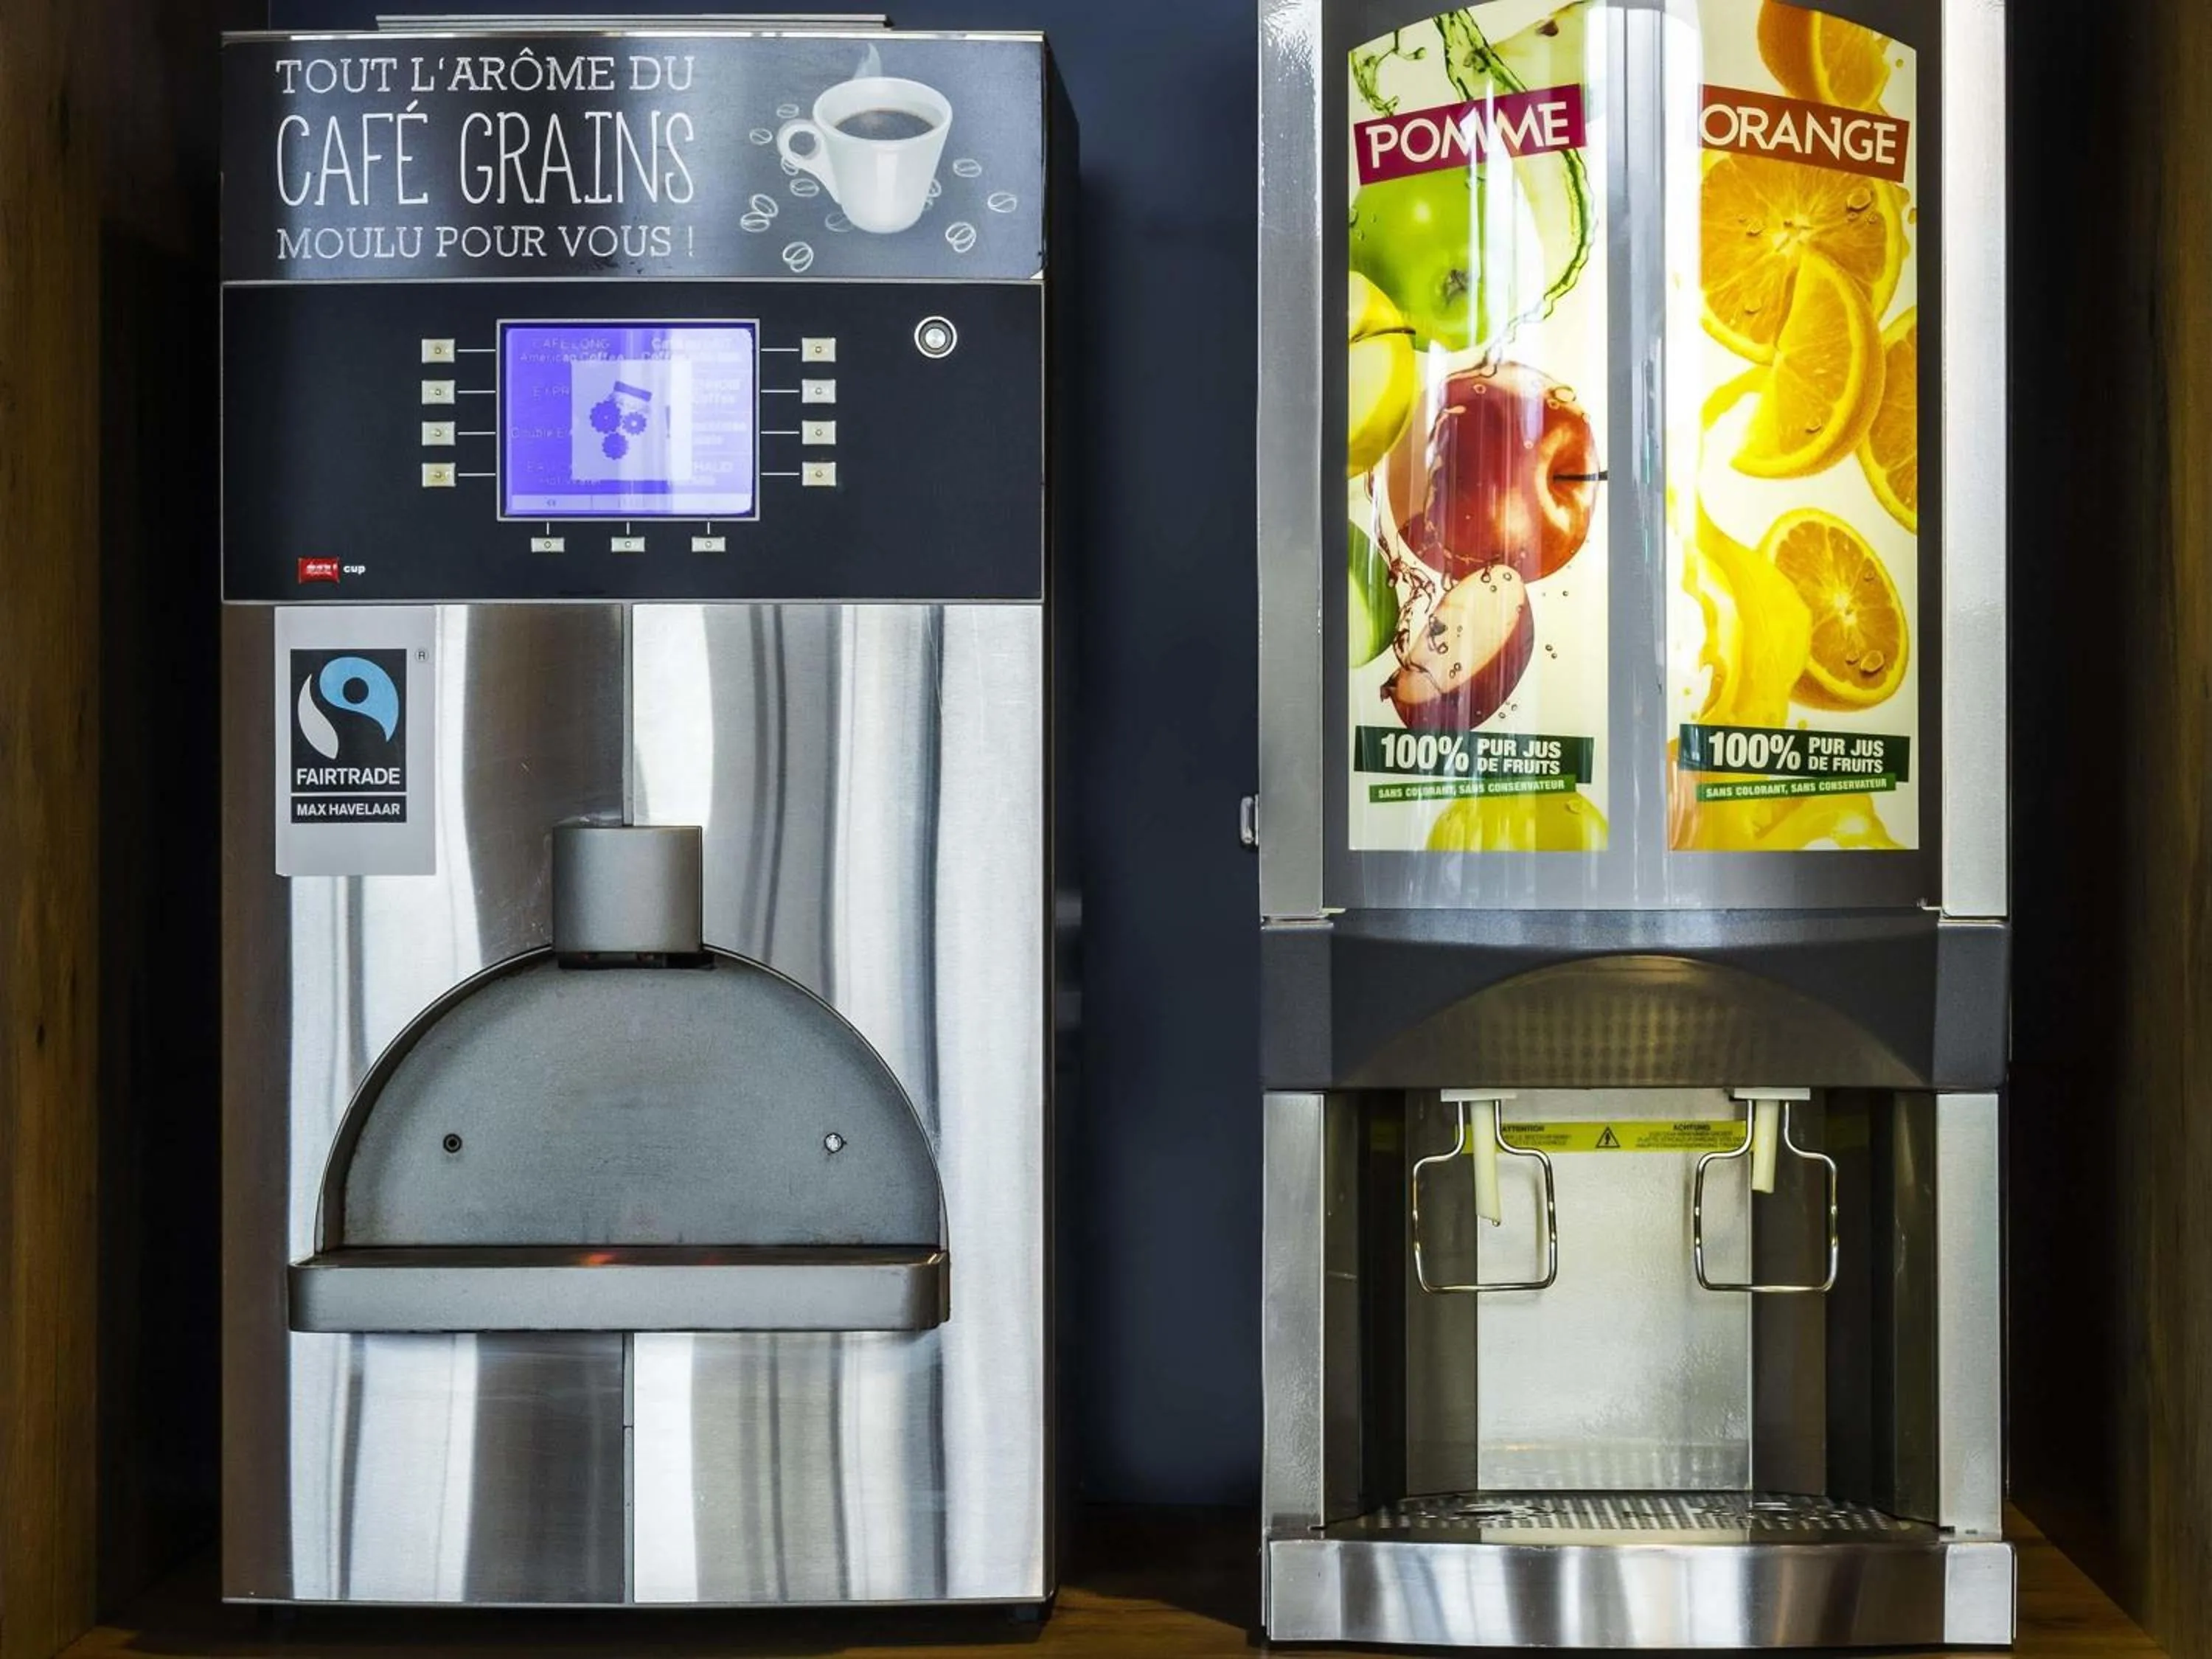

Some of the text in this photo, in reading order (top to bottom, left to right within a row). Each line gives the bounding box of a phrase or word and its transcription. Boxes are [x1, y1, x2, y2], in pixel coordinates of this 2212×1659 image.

[276, 58, 397, 94] TOUT
[629, 56, 695, 91] DU
[1366, 102, 1570, 168] POMME
[1699, 104, 1898, 164] ORANGE
[276, 100, 695, 206] CAFÉ GRAINS
[276, 227, 423, 260] MOULU
[435, 226, 548, 257] POUR
[557, 226, 672, 257] VOUS
[343, 566, 366, 575] cup
[1381, 733, 1562, 772] 100% PUR JUS
[1708, 731, 1885, 771] 100% PUR JUS
[296, 768, 401, 785] FAIRTRADE
[1477, 757, 1561, 775] DE FRUITS
[1809, 756, 1884, 774] DE FRUITS
[1488, 779, 1565, 793] CONSERVATEUR
[1706, 787, 1733, 797] SANS
[1791, 782, 1816, 793] SANS
[1819, 778, 1888, 793] CONSERVATEUR
[297, 803, 400, 815] MAX HAVELAAR
